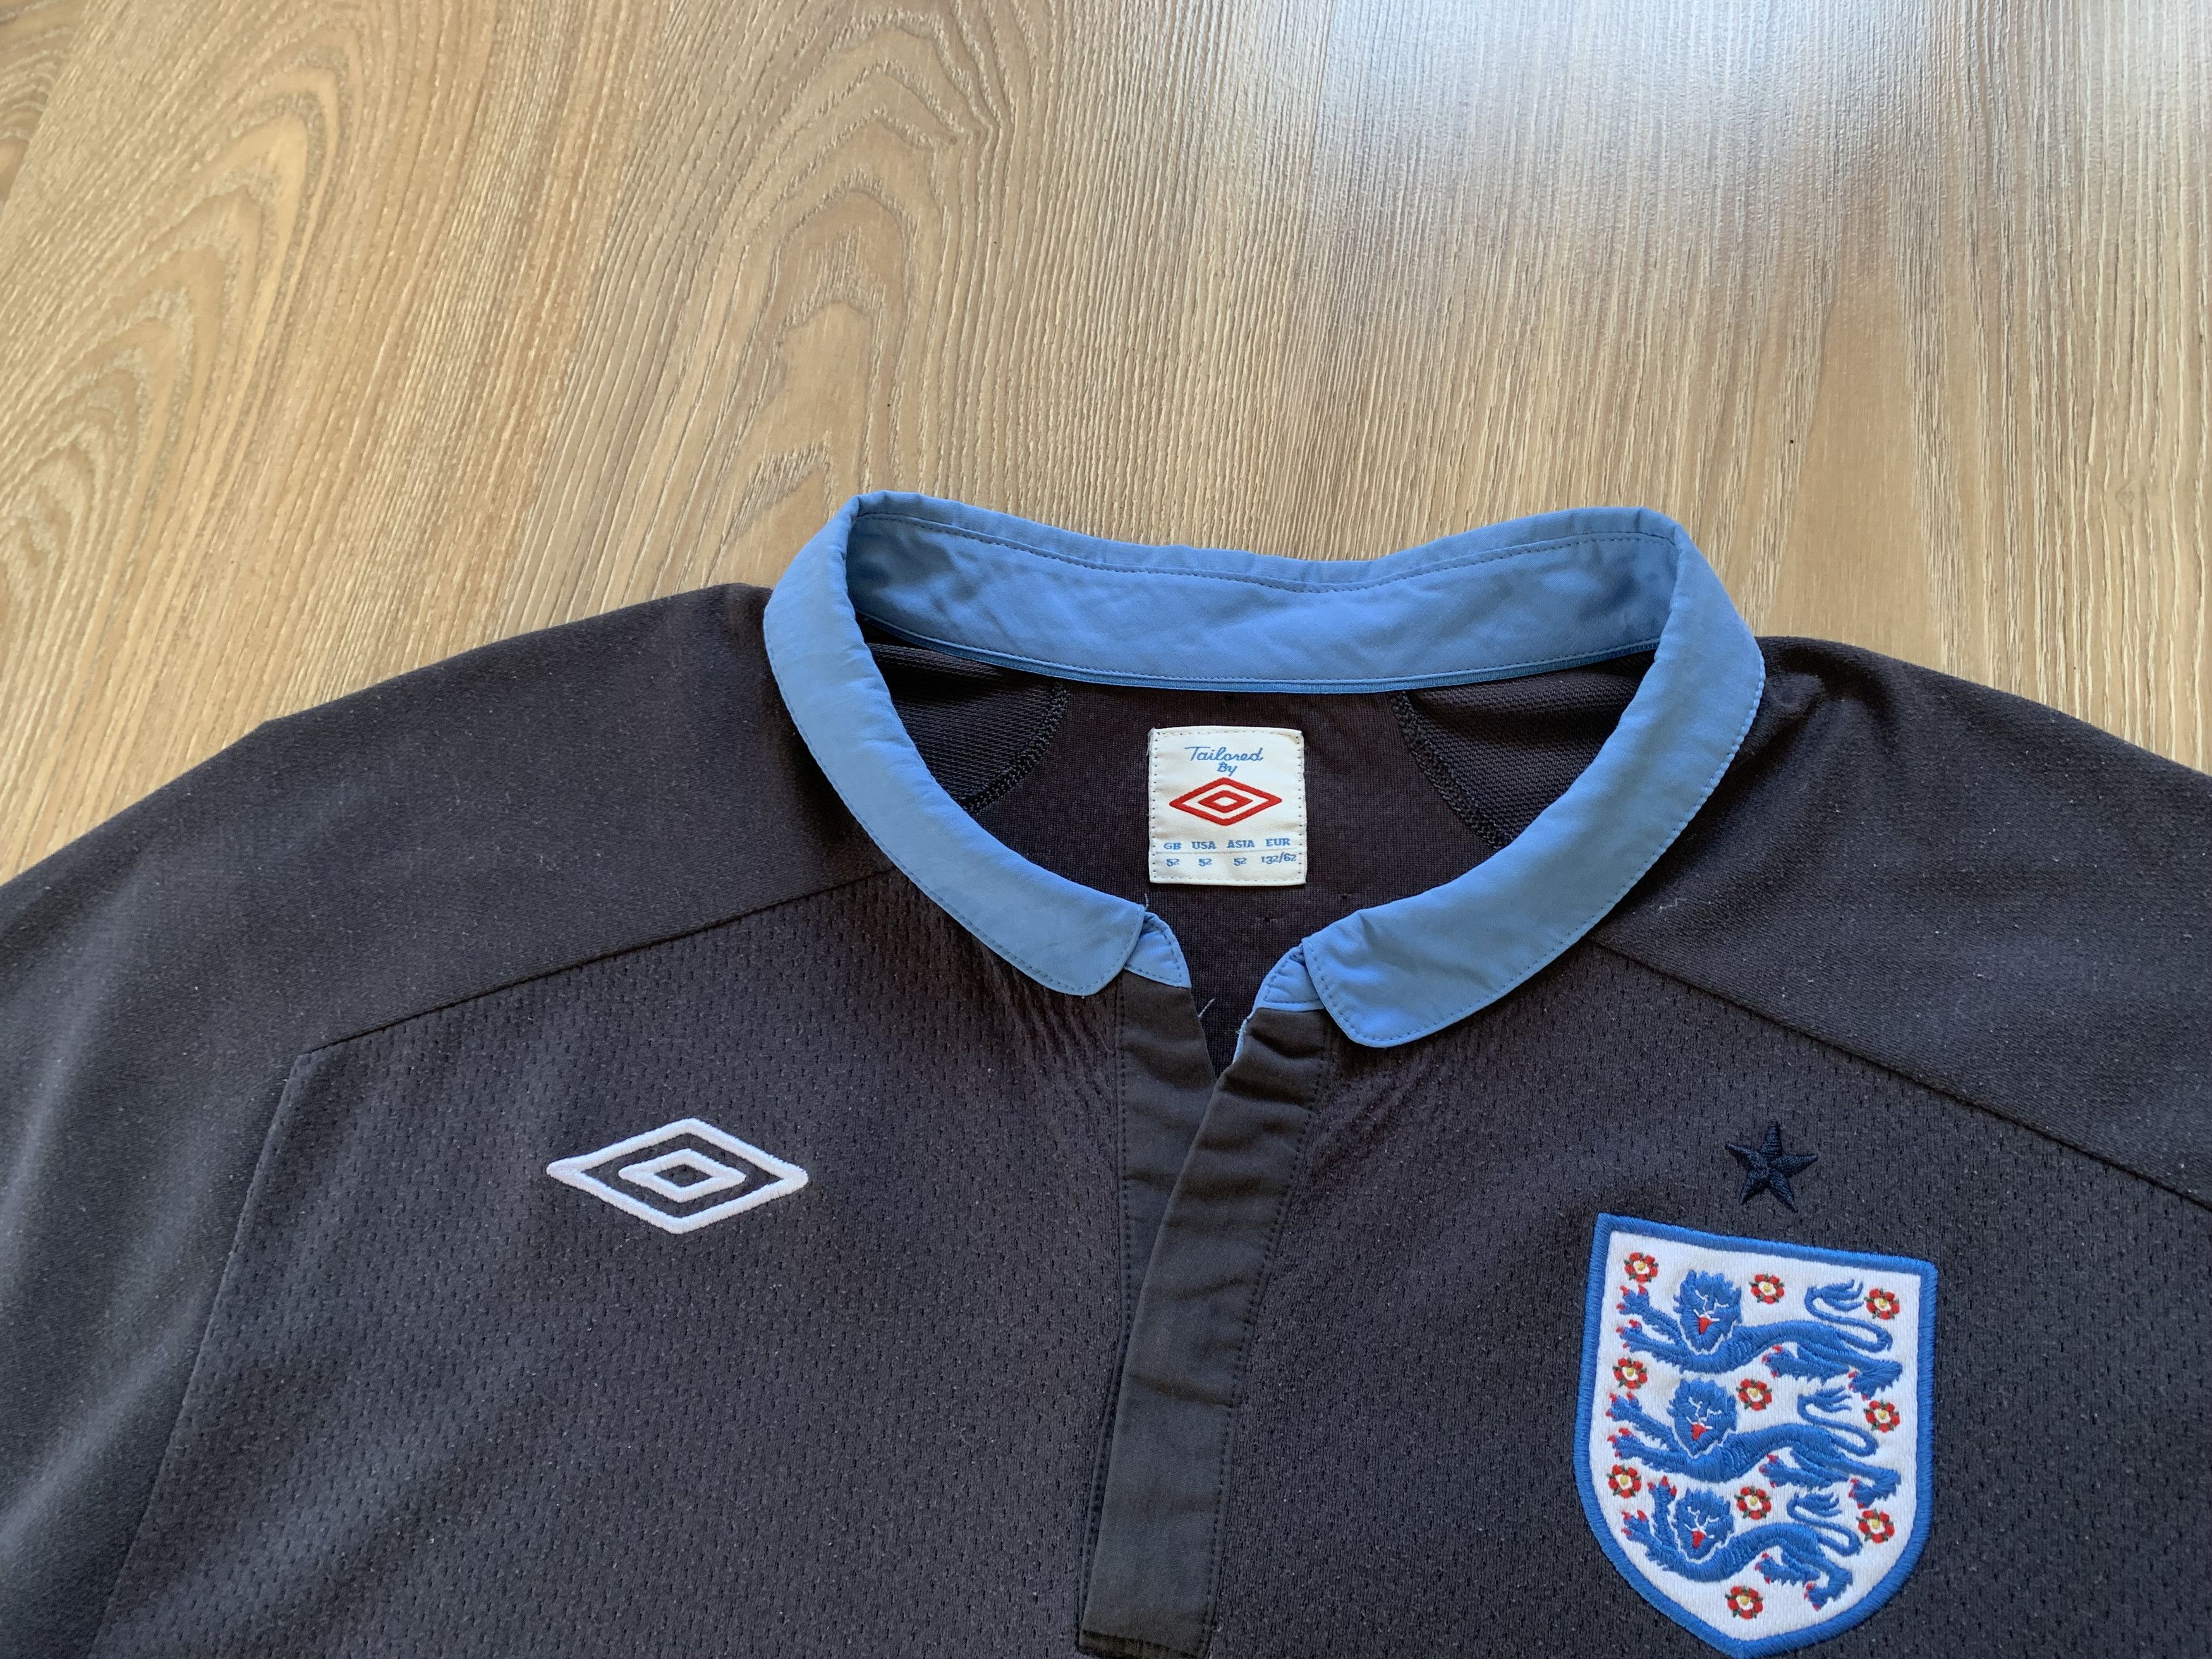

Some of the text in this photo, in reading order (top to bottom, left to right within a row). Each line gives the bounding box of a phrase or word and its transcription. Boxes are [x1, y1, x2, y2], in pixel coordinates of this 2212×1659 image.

[1184, 746, 1264, 761] Tailored
[1217, 762, 1237, 777] By
[1164, 837, 1290, 850] GB USA ASIA EUR
[1166, 858, 1181, 867] 52
[1198, 858, 1212, 867] 52
[1233, 856, 1247, 866] 52
